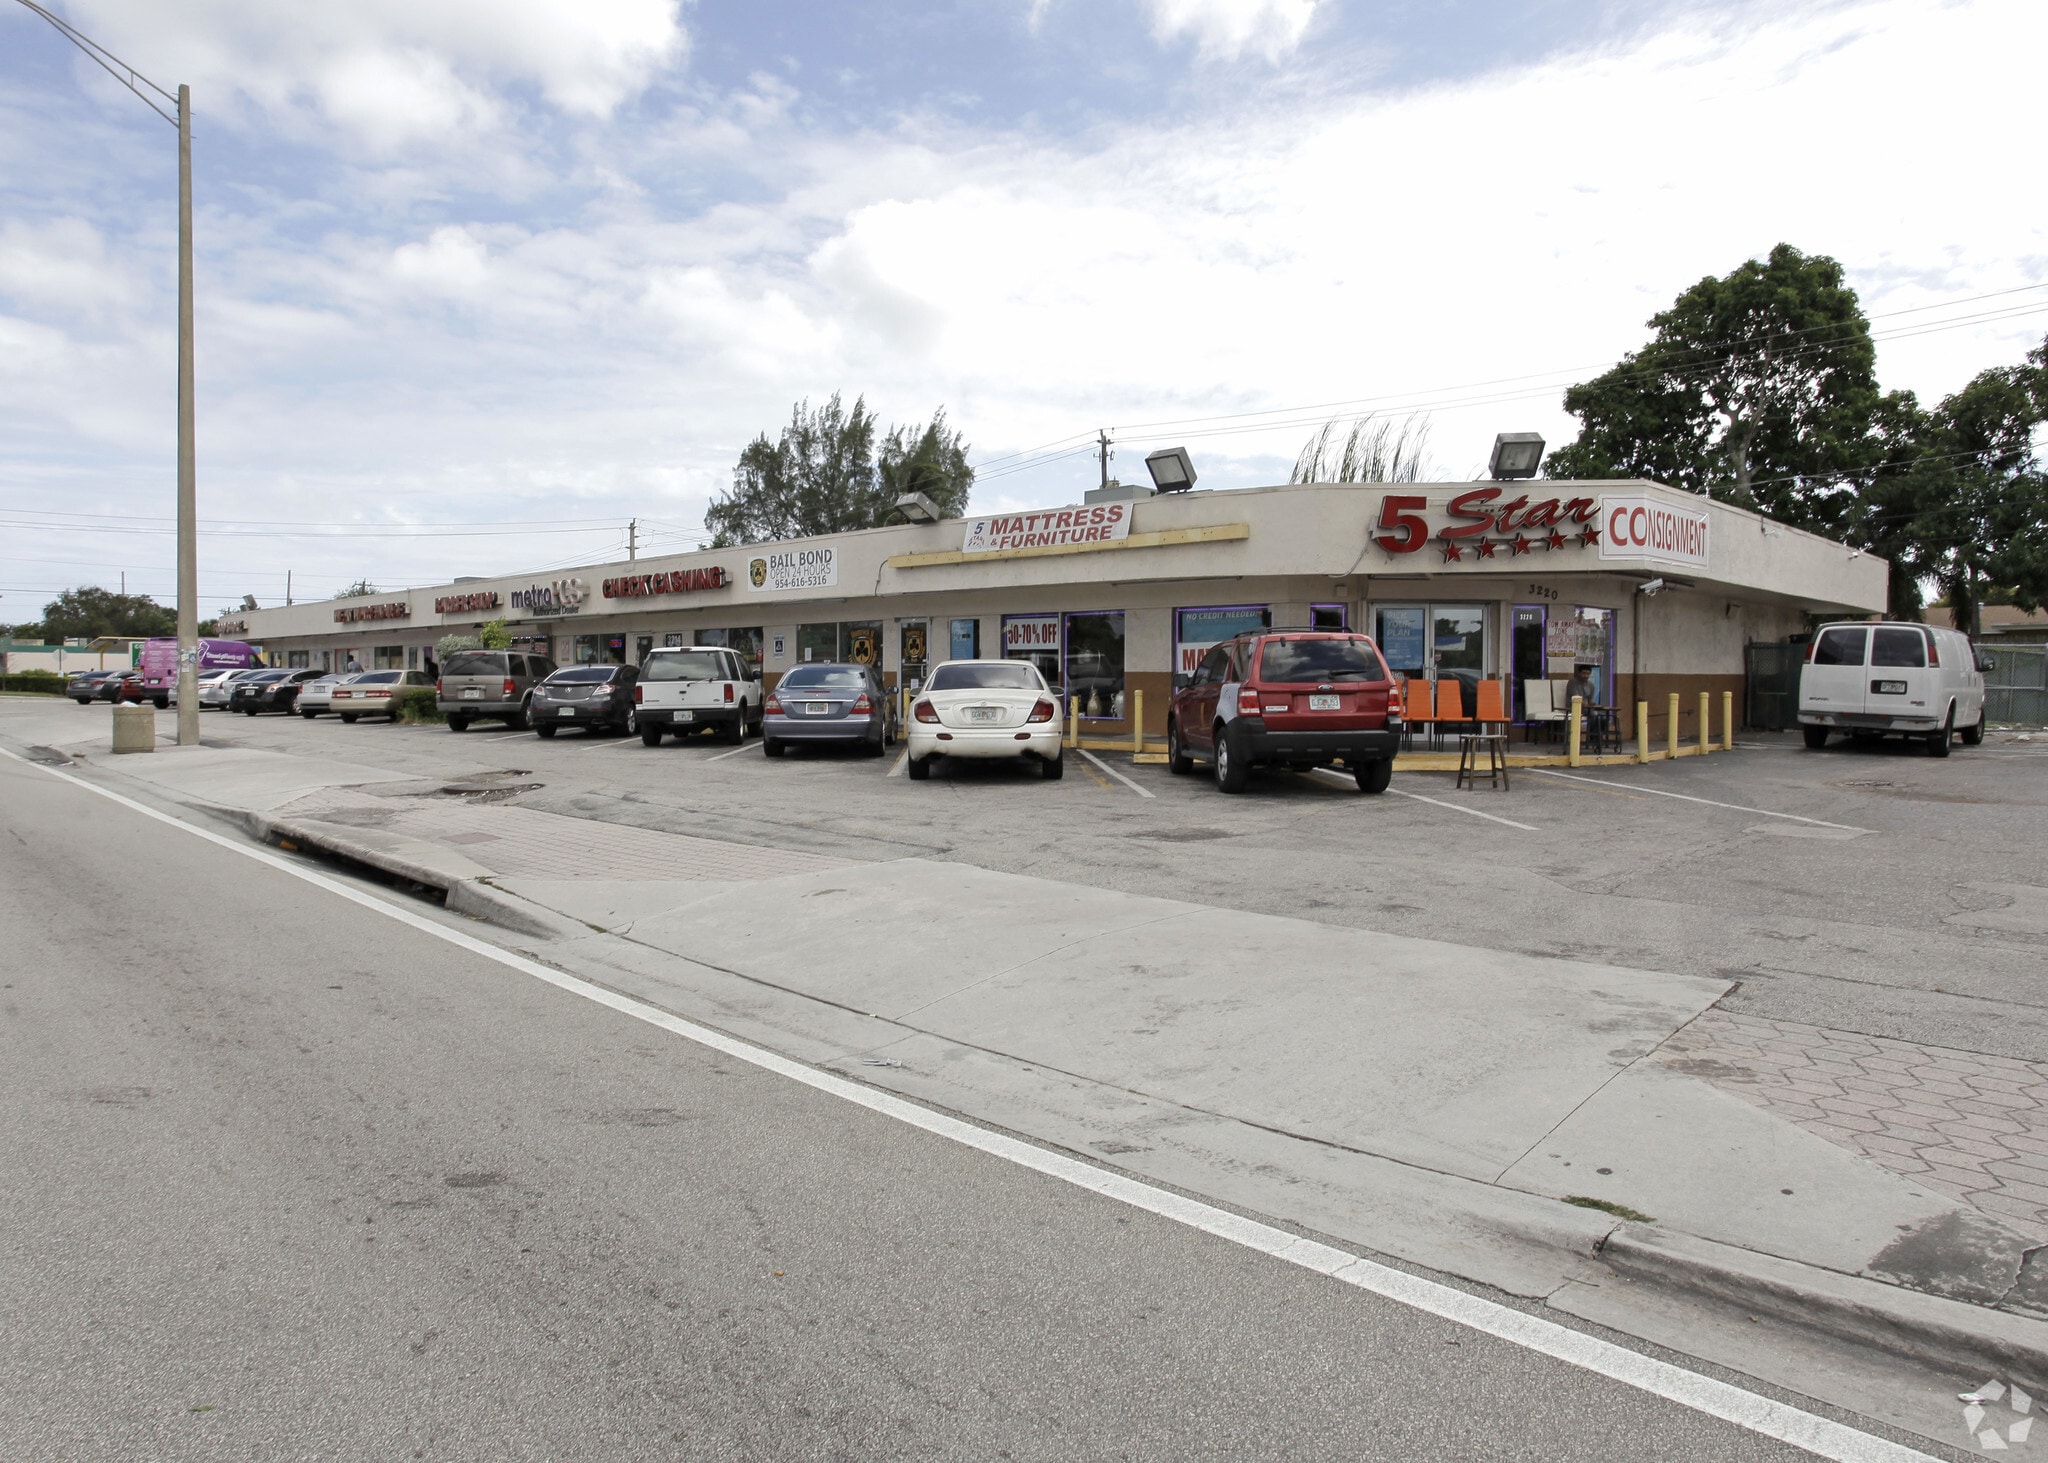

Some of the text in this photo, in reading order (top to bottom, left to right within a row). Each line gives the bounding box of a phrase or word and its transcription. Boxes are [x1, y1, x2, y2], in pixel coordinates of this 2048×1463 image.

[974, 522, 985, 534] 5
[990, 505, 1124, 535] MATTRESS
[1375, 488, 1601, 553] 5 Star
[991, 525, 1114, 549] & FURNITURE
[1609, 506, 1707, 558] CONSIGNMENT
[770, 549, 832, 569] BAIL BOND
[770, 563, 831, 579] OPEN 24 HOURS
[602, 566, 721, 599] CHECK CASHING
[775, 575, 827, 588] 954-616-5316
[511, 578, 584, 609] metroPCS
[1529, 584, 1558, 600] 3220
[533, 605, 580, 617] Authorized Dealer
[1186, 613, 1197, 621] NO
[1199, 612, 1225, 620] CREDIT
[1387, 611, 1408, 619] PICK
[1387, 620, 1412, 628] YOUR
[1554, 627, 1567, 635] ZONE
[1041, 623, 1057, 644] OFF
[1387, 629, 1411, 637] PLAN
